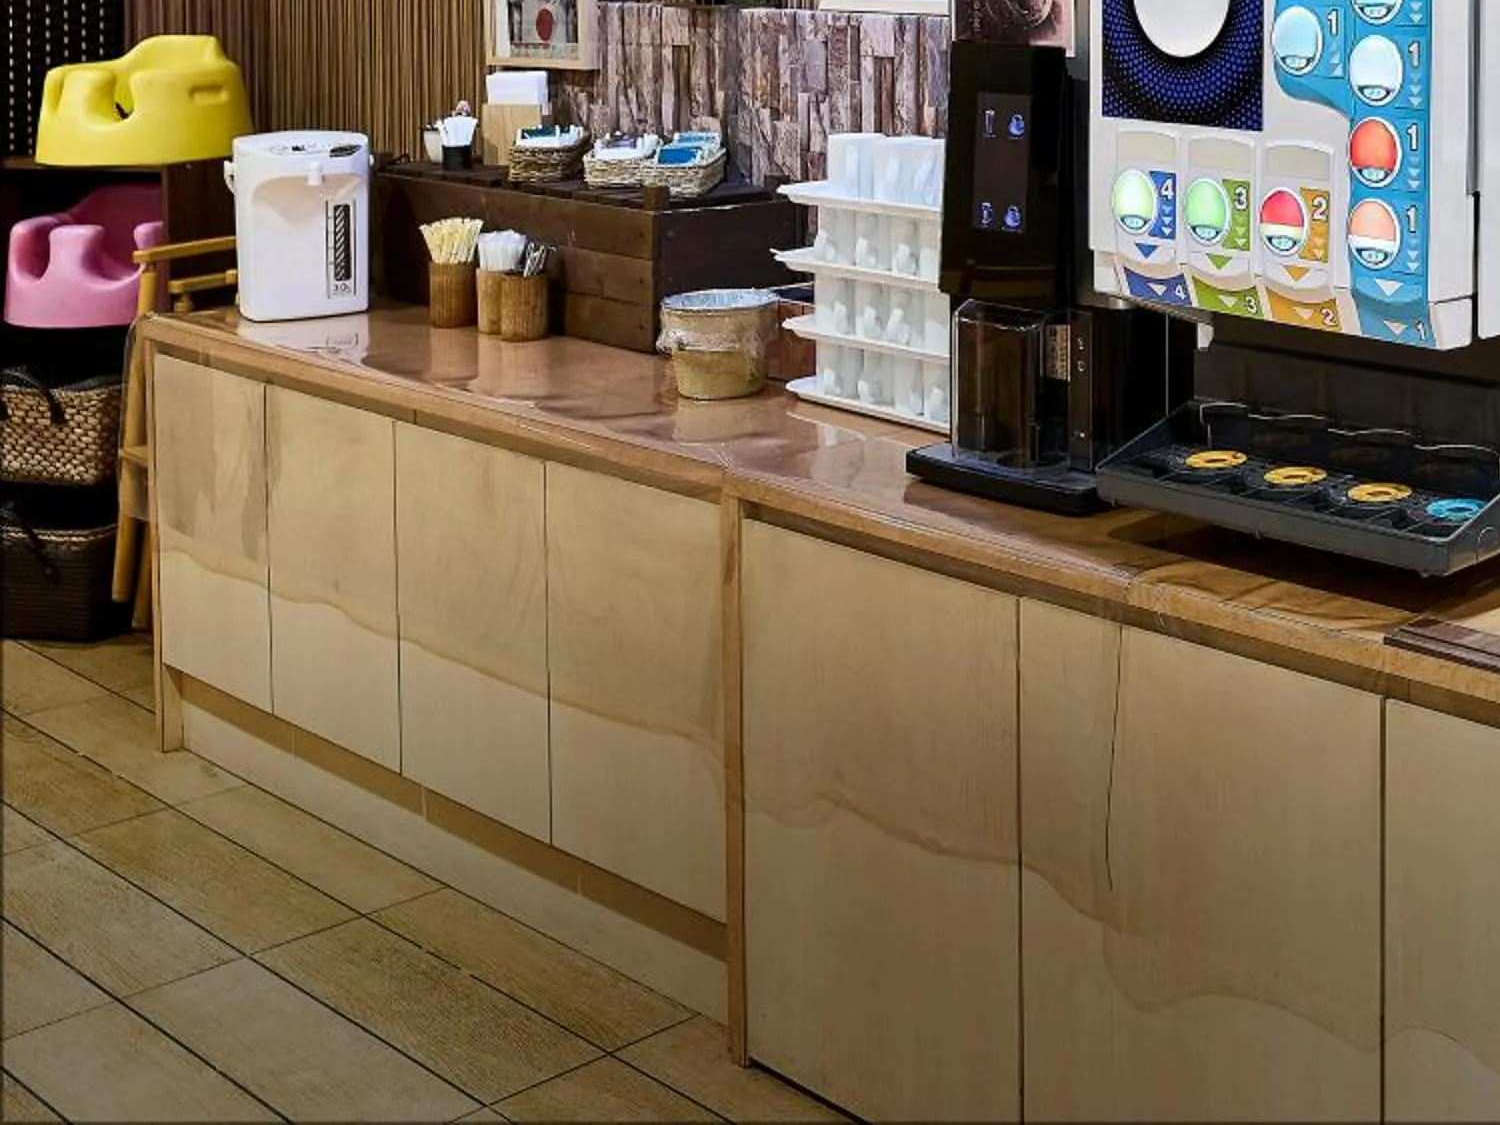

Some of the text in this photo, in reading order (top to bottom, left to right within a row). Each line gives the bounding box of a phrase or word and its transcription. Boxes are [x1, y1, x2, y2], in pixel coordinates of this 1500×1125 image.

[1327, 8, 1339, 36] 1
[1408, 41, 1421, 68] 1
[1406, 123, 1419, 151] 1
[1160, 179, 1174, 200] 4
[1234, 187, 1248, 210] 3
[1312, 195, 1328, 221] 2
[1405, 205, 1417, 234] 1
[1174, 285, 1186, 299] 4
[1246, 296, 1258, 314] 3
[1321, 309, 1334, 326] 2
[1416, 321, 1426, 340] 1
